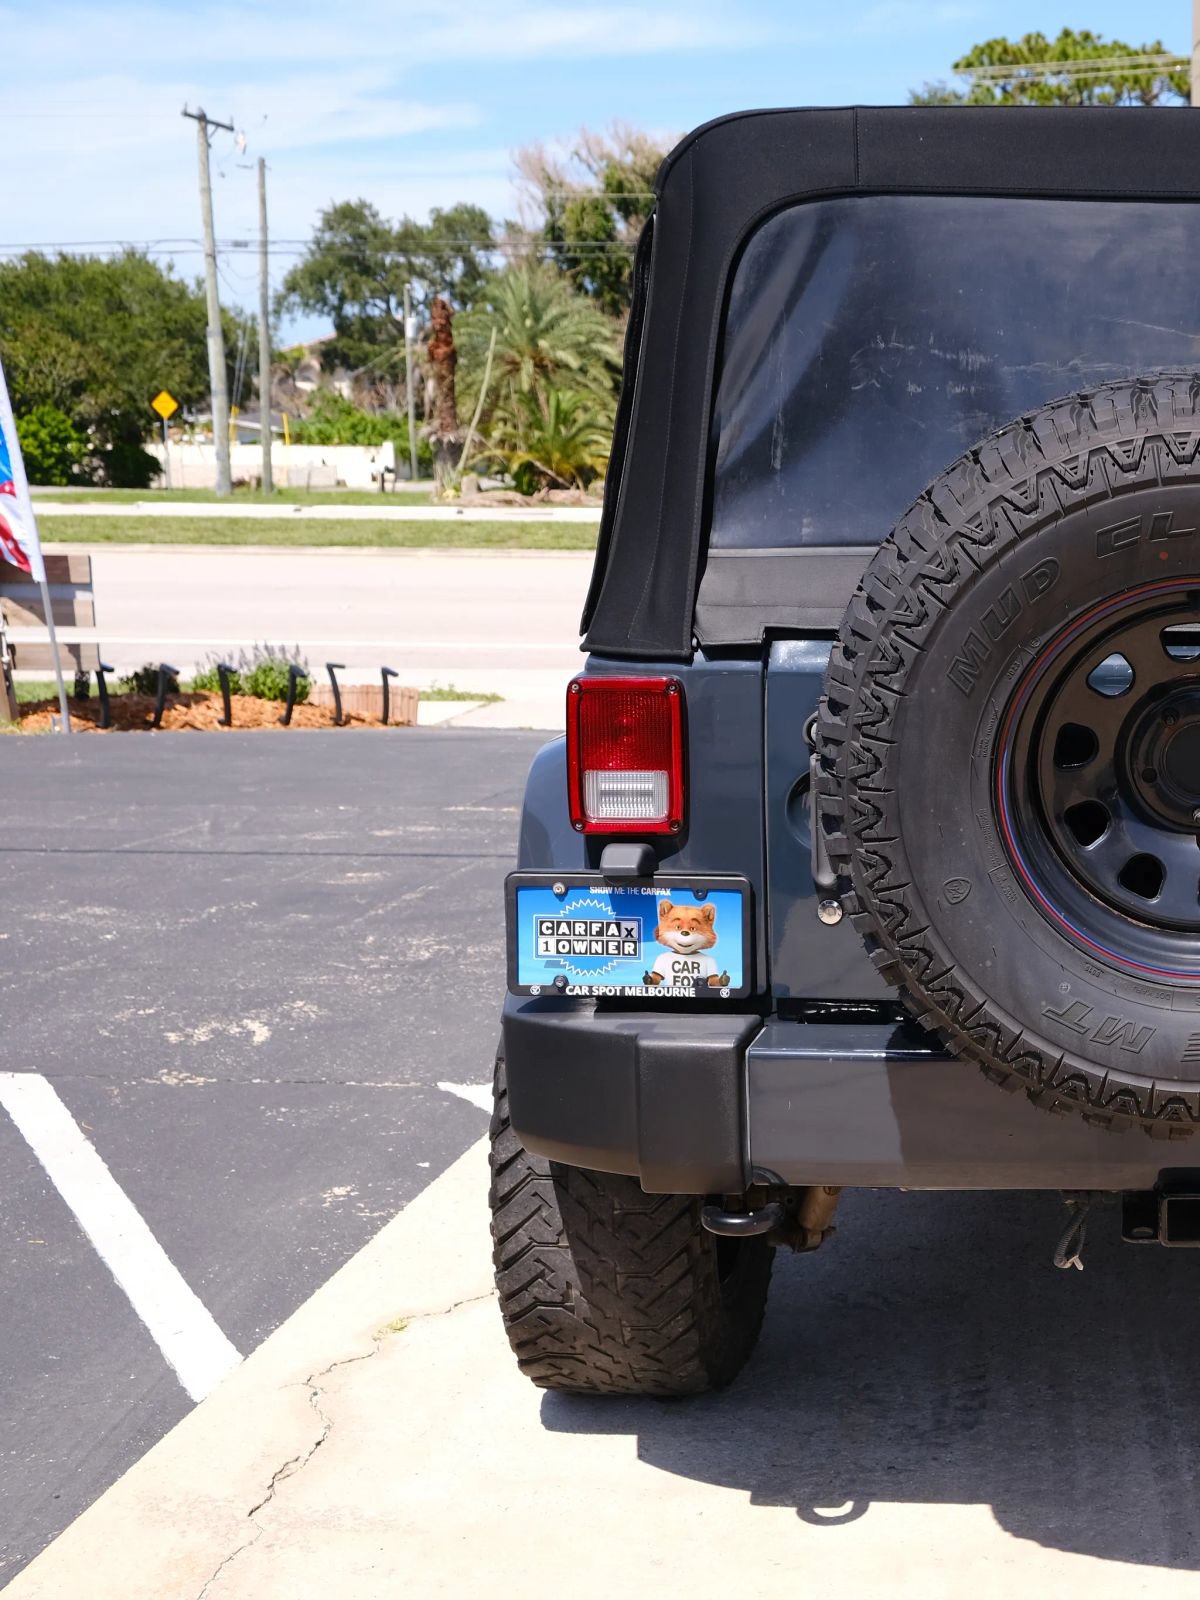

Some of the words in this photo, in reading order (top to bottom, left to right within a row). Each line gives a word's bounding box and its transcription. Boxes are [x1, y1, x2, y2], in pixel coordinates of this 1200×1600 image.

[946, 556, 1061, 697] MUD
[589, 886, 613, 895] SHOW
[614, 886, 625, 895] ME
[627, 887, 640, 895] THE
[641, 887, 672, 896] CARFAX
[541, 921, 635, 938] CARFAX
[671, 960, 701, 974] CAR
[565, 985, 590, 996] CAR
[592, 986, 622, 996] SPOT
[625, 986, 696, 998] MELBOURNE
[1041, 1000, 1157, 1054] MT
